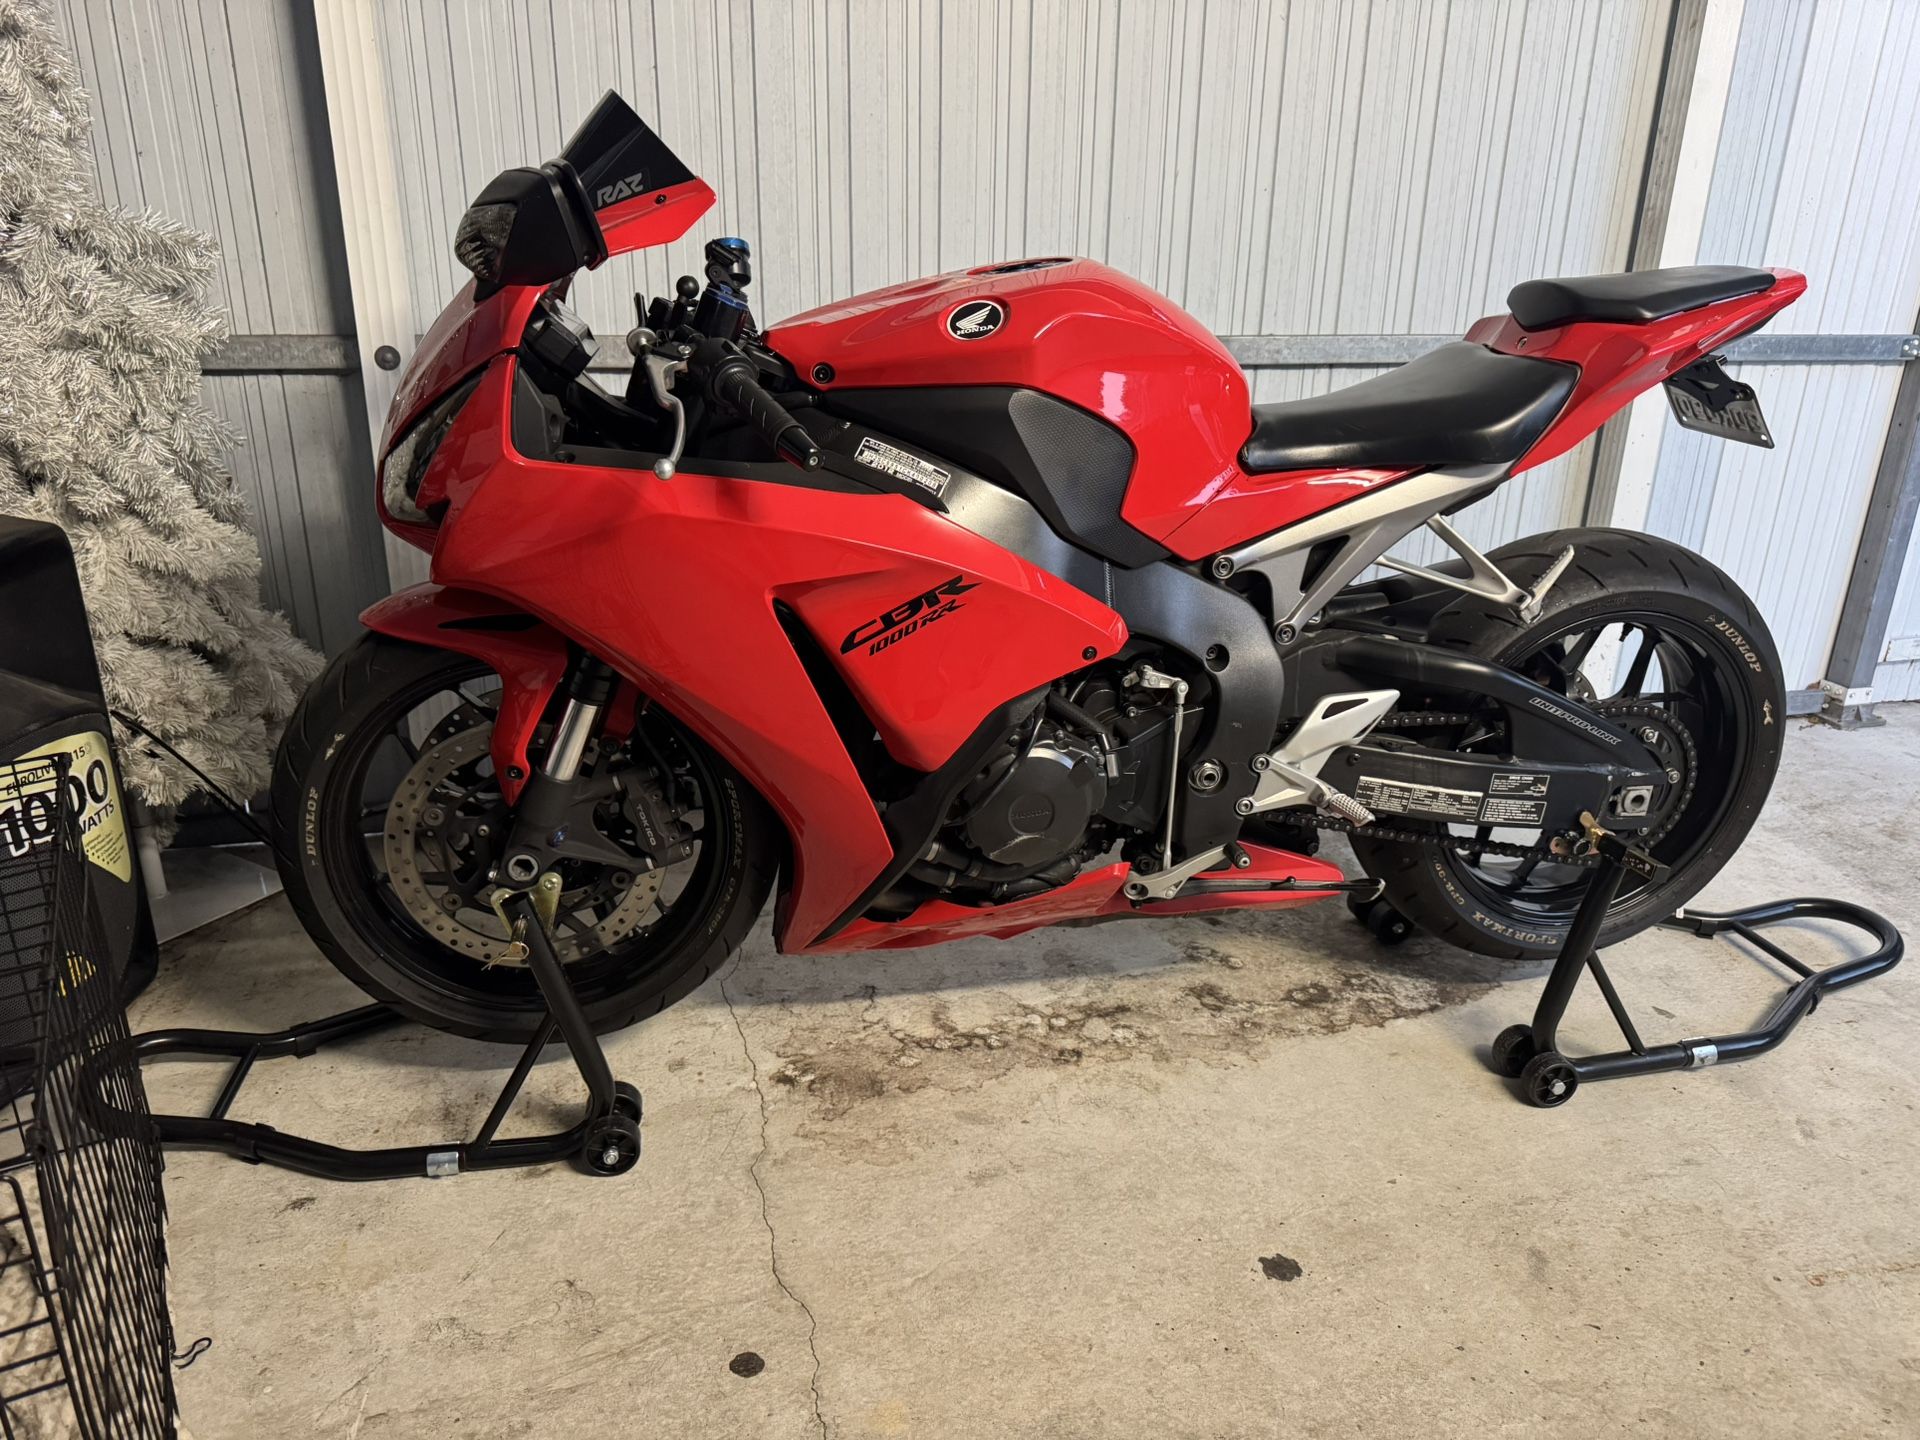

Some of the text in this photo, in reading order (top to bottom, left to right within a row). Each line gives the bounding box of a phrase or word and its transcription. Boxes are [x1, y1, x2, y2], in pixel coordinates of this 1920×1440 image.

[597, 172, 644, 207] RAZ
[956, 324, 995, 336] HONDA
[839, 574, 983, 655] CBR
[1714, 620, 1762, 673] DUNLOP
[6, 760, 57, 796] EUROLIV
[304, 786, 320, 857] DUNLOP
[636, 803, 657, 847] TOKICO
[1471, 910, 1558, 945] SPORTMAX
